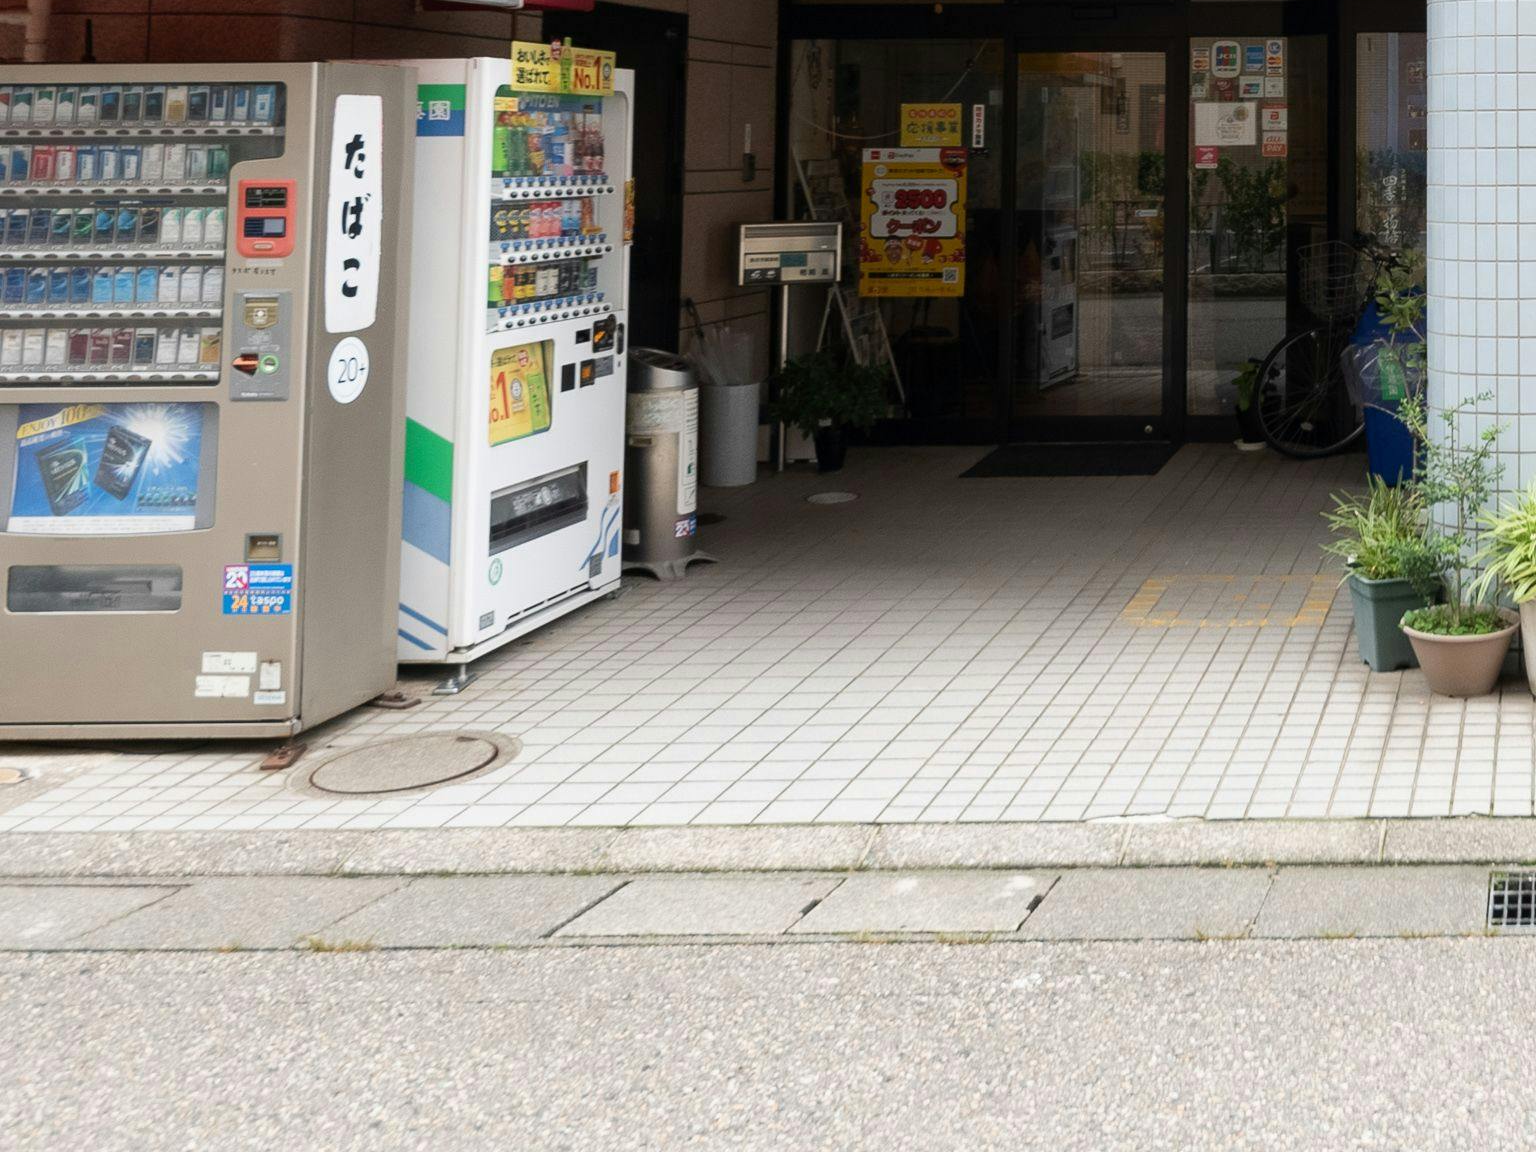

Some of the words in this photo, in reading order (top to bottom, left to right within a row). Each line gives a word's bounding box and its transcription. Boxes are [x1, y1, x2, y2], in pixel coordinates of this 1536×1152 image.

[341, 133, 372, 299] たばこ
[886, 217, 943, 234] クーポン
[337, 357, 367, 384] 20+
